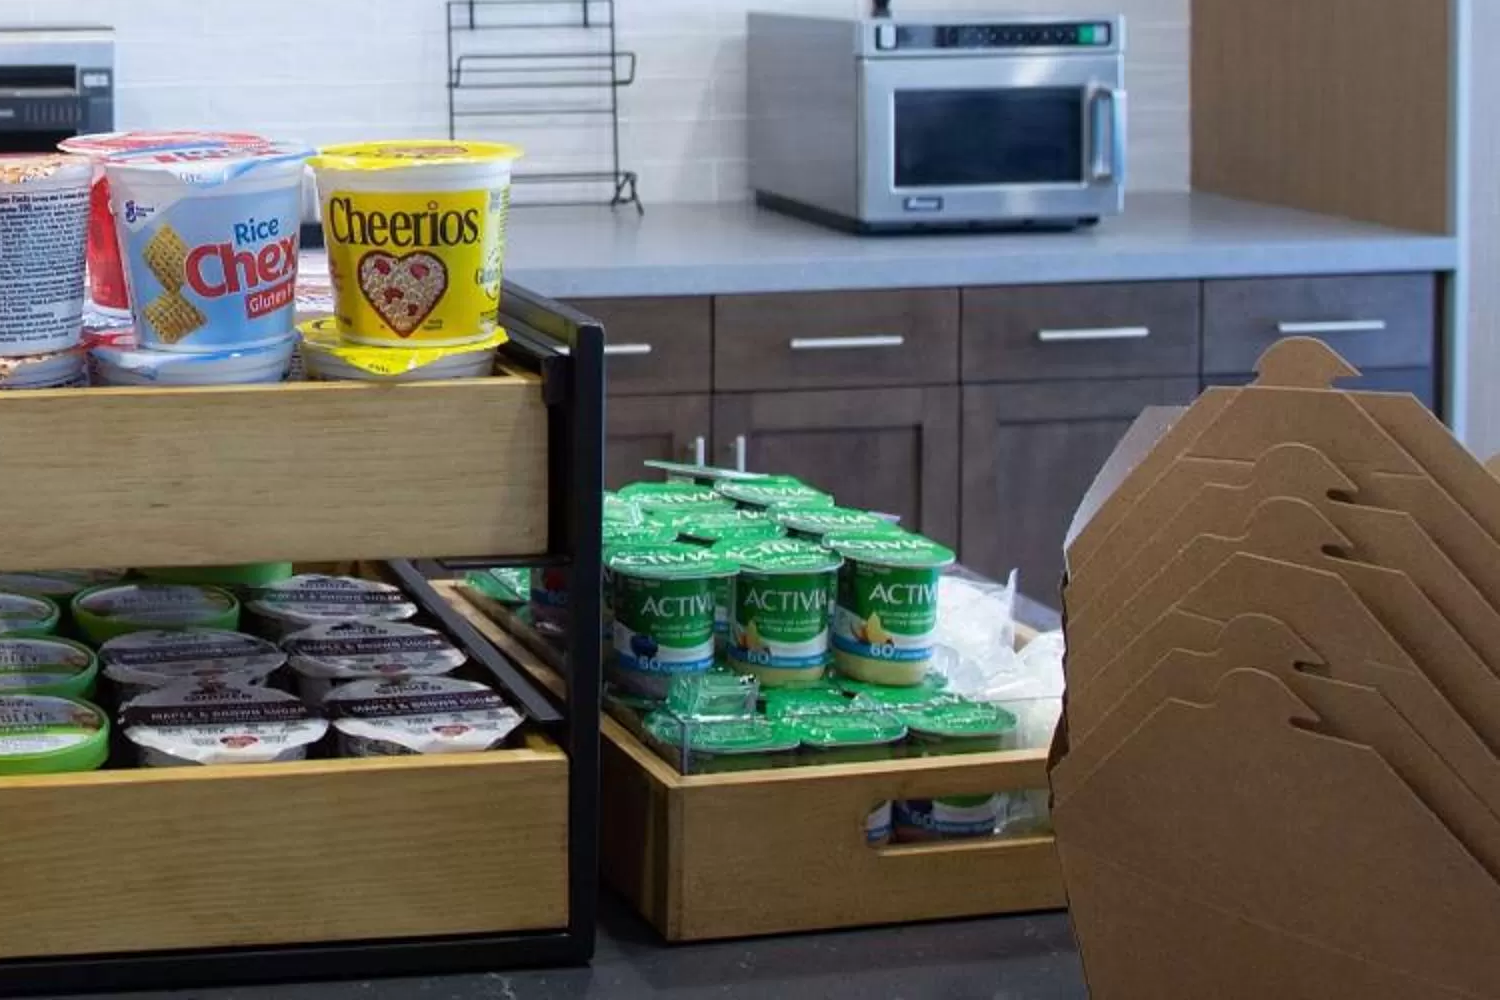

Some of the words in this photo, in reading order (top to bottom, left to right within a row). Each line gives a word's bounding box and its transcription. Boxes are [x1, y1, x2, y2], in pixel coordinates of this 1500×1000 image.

[233, 217, 280, 246] Rice
[329, 196, 479, 247] Cheerios
[185, 232, 297, 299] Chex
[250, 289, 287, 313] Gluten
